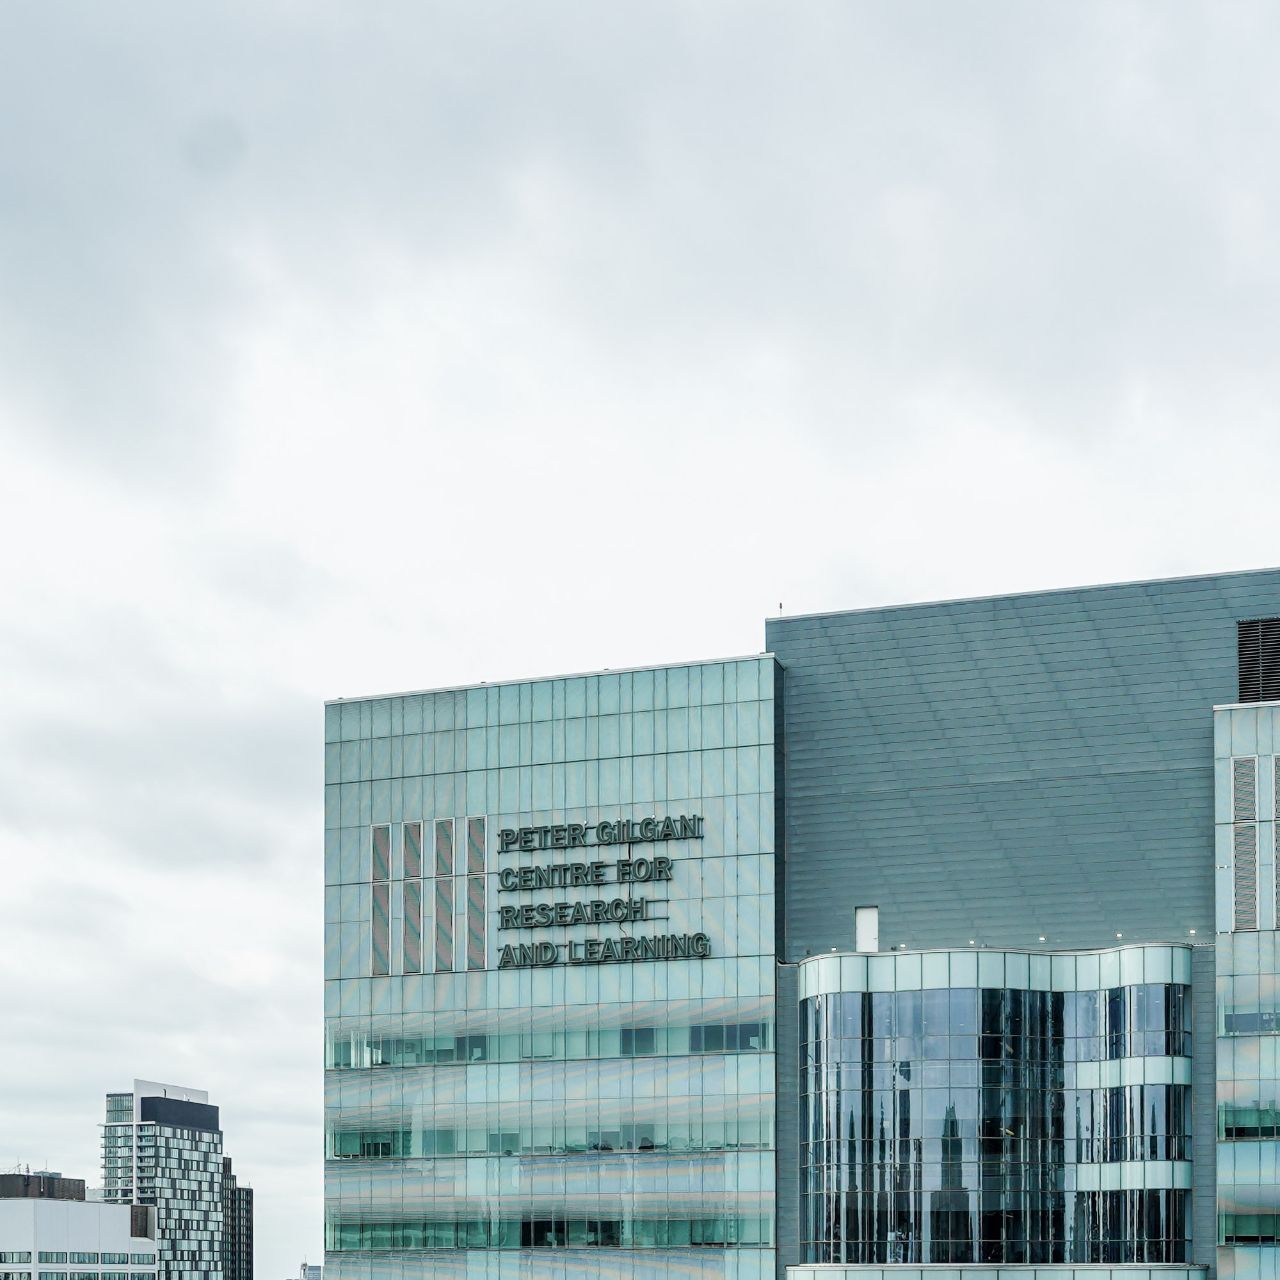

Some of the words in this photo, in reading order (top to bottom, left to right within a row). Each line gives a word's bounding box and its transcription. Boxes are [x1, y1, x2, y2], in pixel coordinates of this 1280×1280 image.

[500, 823, 586, 850] PETER
[596, 815, 700, 844] GILGAN
[500, 861, 604, 890] CENTRE
[616, 857, 672, 882] FOR
[500, 898, 647, 928] RESEARCH
[499, 942, 558, 967] AND
[568, 933, 711, 962] LEARNING
